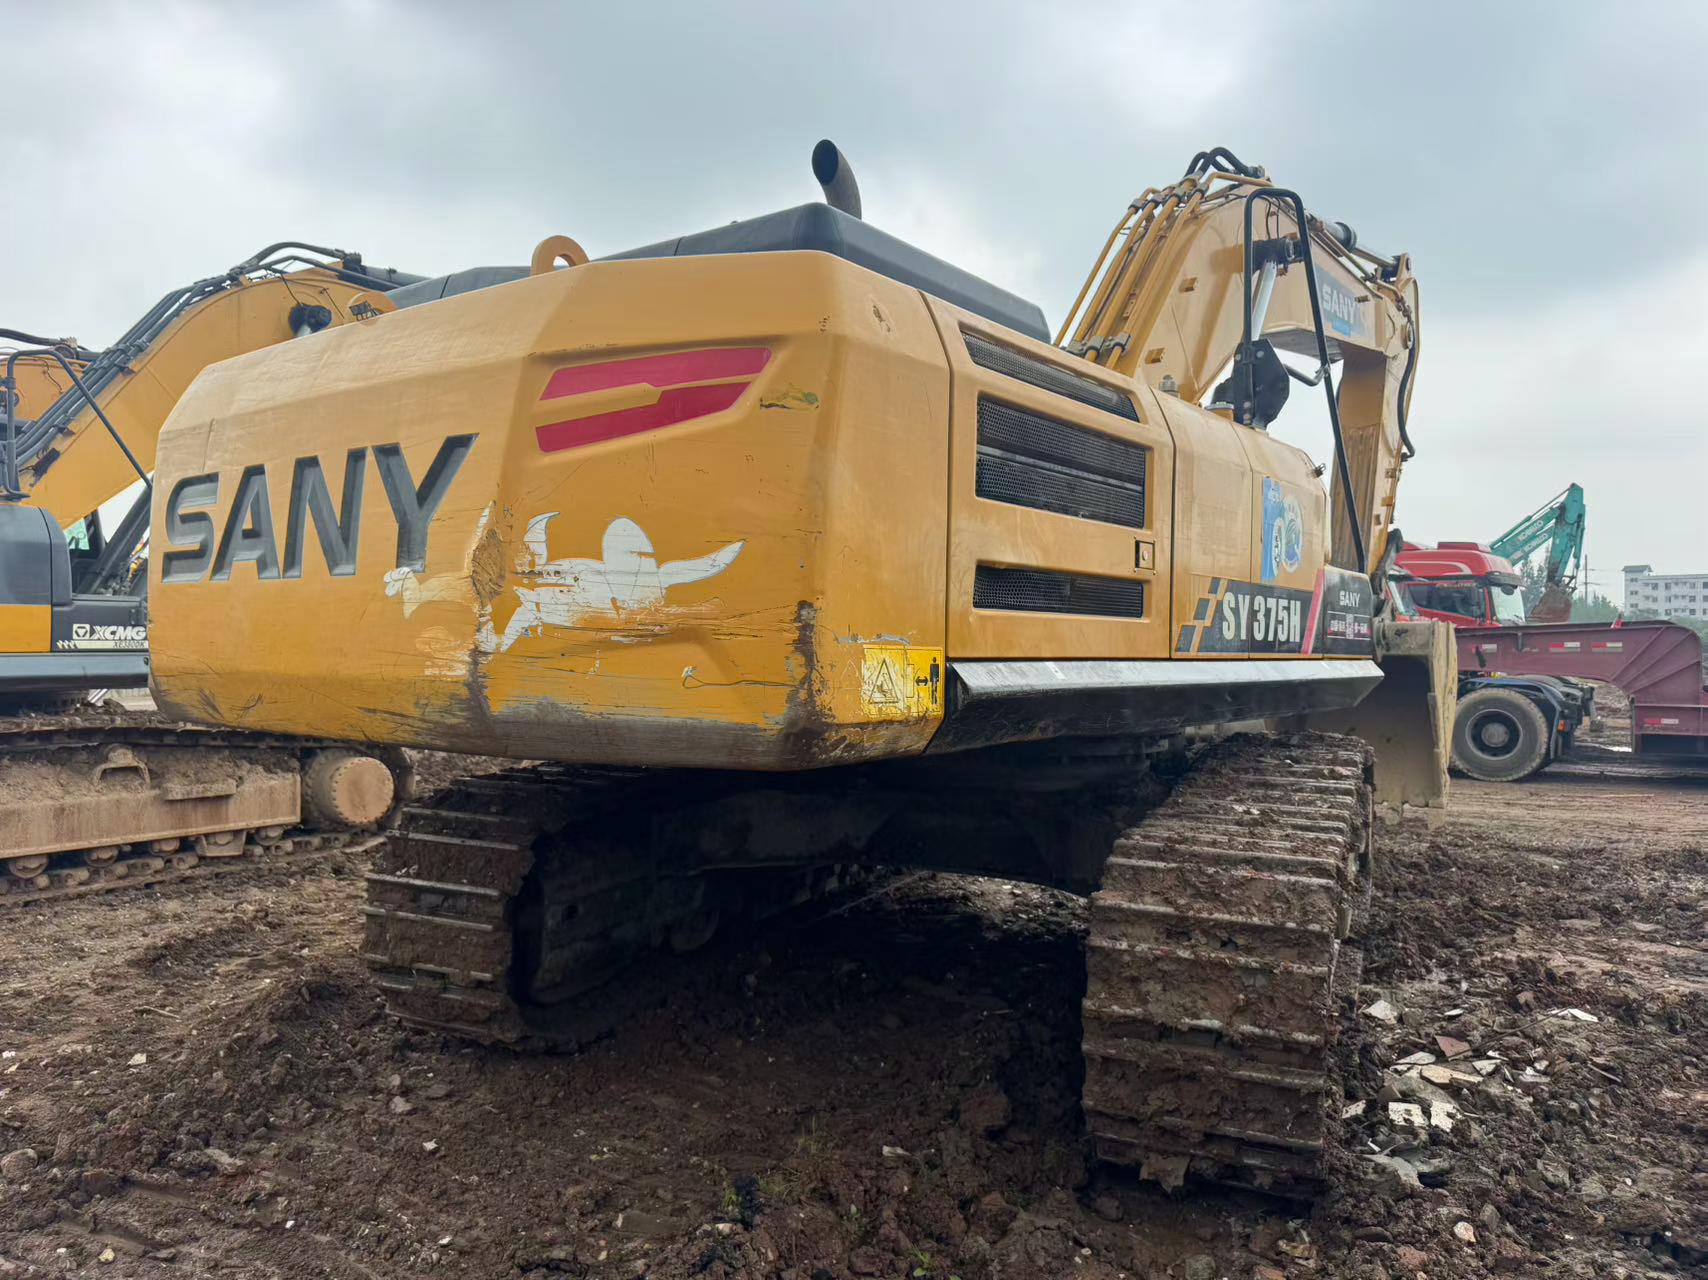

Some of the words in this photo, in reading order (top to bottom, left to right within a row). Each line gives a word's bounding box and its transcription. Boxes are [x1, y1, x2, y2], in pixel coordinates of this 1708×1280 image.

[1322, 283, 1356, 323] SANY
[161, 432, 480, 583] SANY
[1222, 591, 1302, 643] SY375H
[1339, 590, 1361, 608] SANY
[89, 625, 147, 640] XCMG
